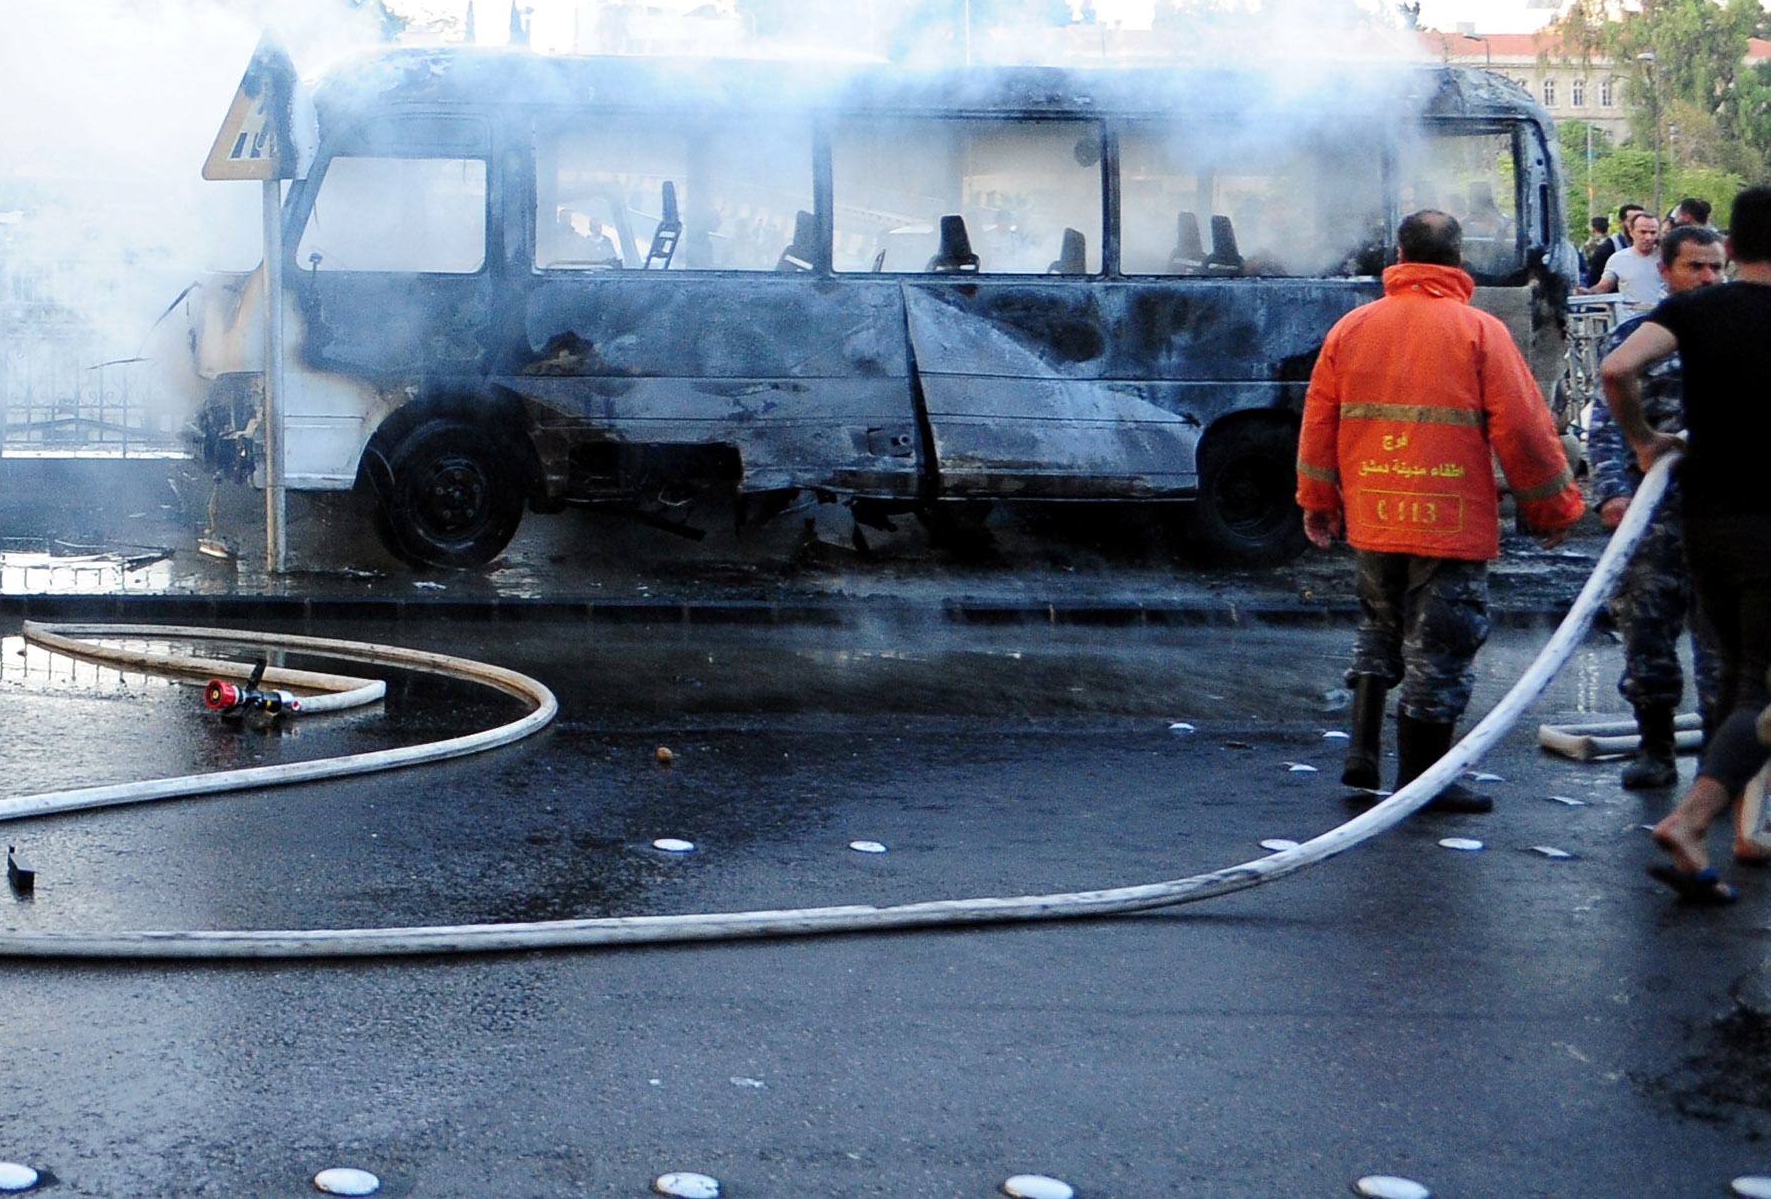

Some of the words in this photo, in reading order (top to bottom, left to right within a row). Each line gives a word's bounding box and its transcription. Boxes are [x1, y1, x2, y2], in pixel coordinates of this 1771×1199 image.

[1382, 431, 1408, 451] فوج
[1358, 459, 1389, 477] دمشق
[1392, 459, 1427, 478] مدينة
